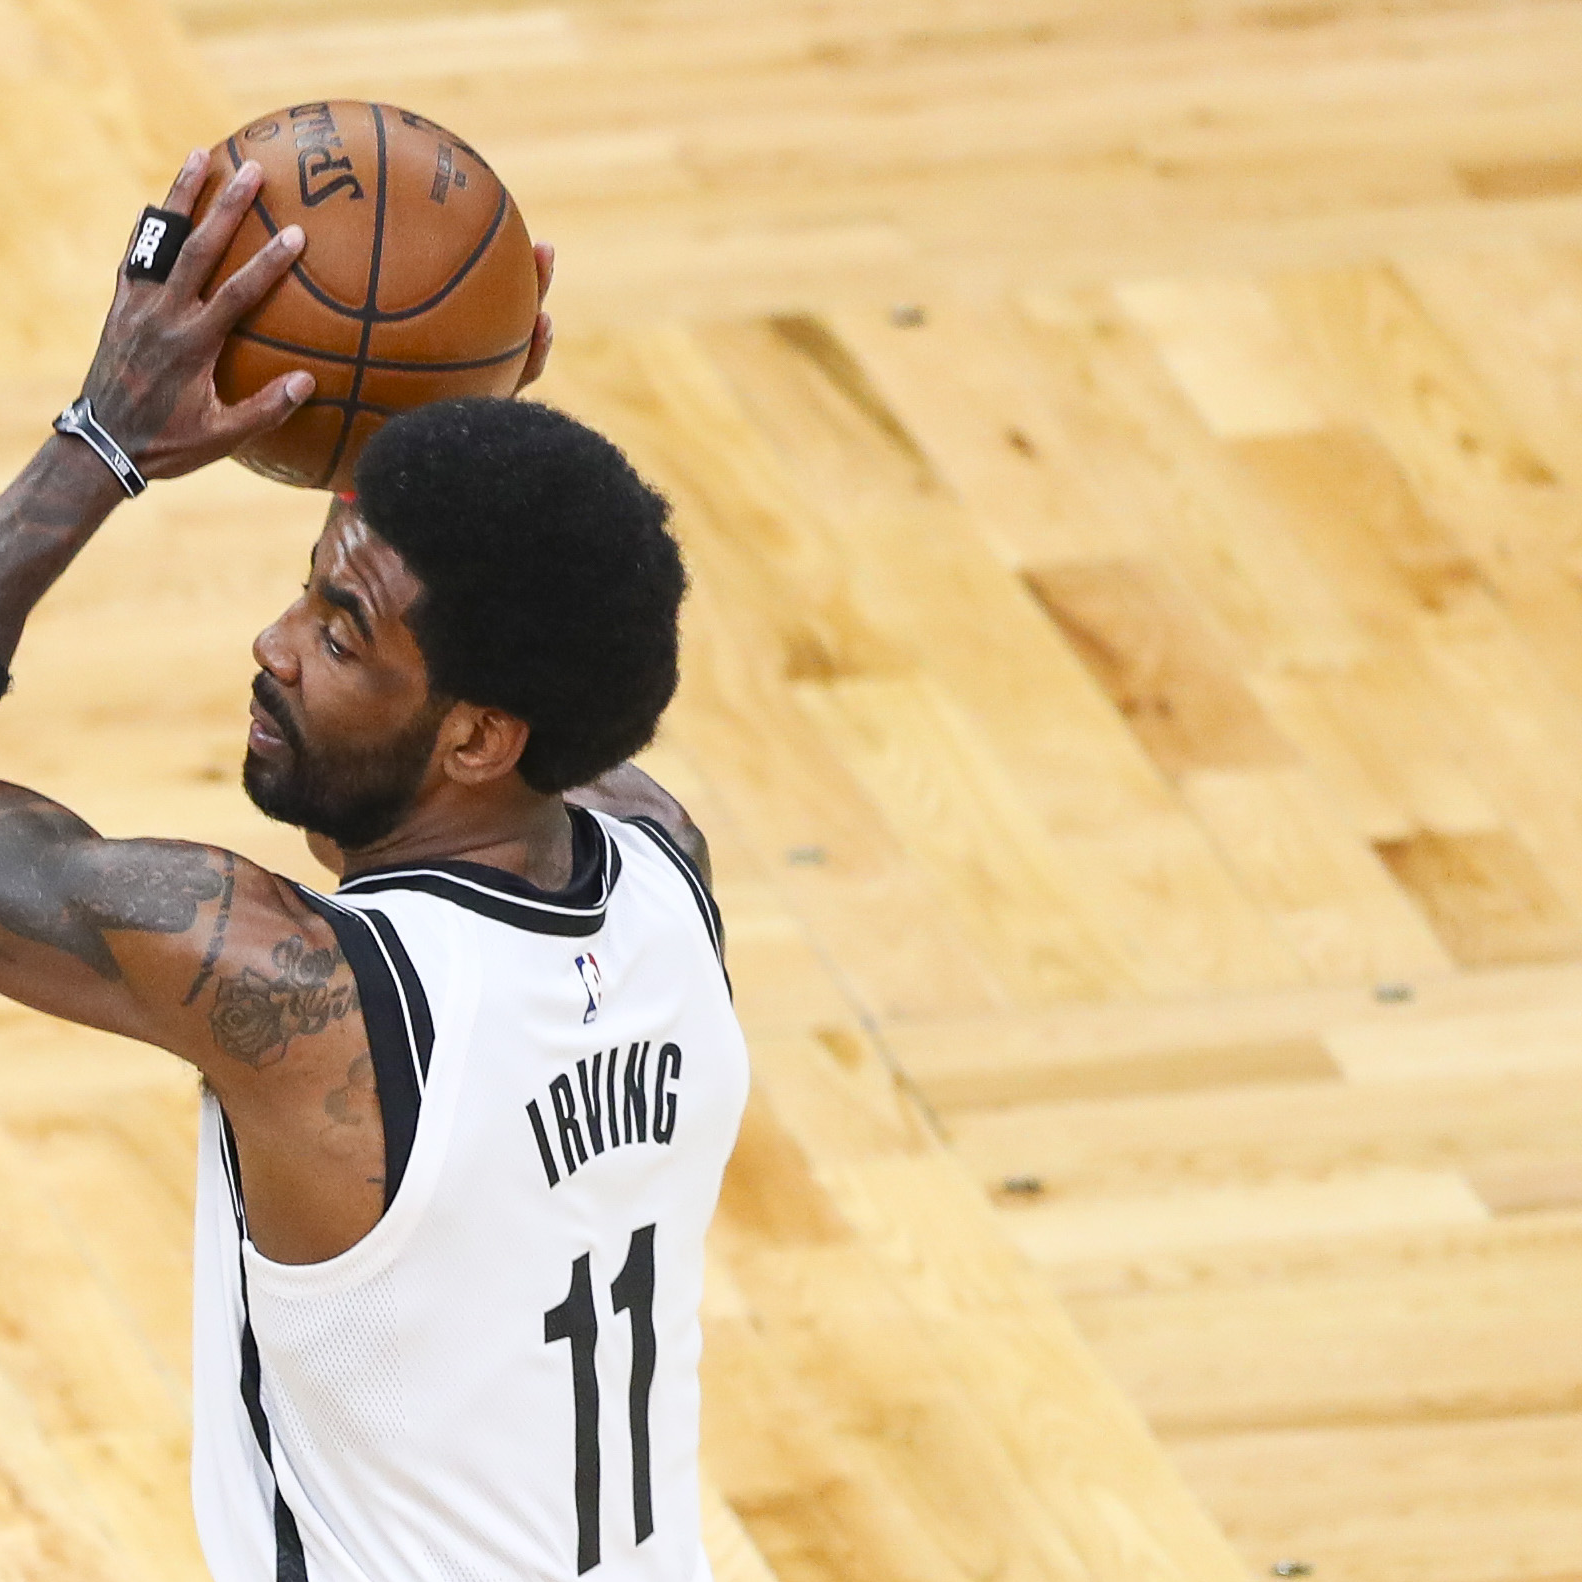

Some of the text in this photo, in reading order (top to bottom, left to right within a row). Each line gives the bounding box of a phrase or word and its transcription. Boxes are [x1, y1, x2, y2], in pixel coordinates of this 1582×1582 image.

[130, 216, 168, 270] 369
[525, 1040, 683, 1190] IRVING
[543, 1222, 657, 1578] 11
